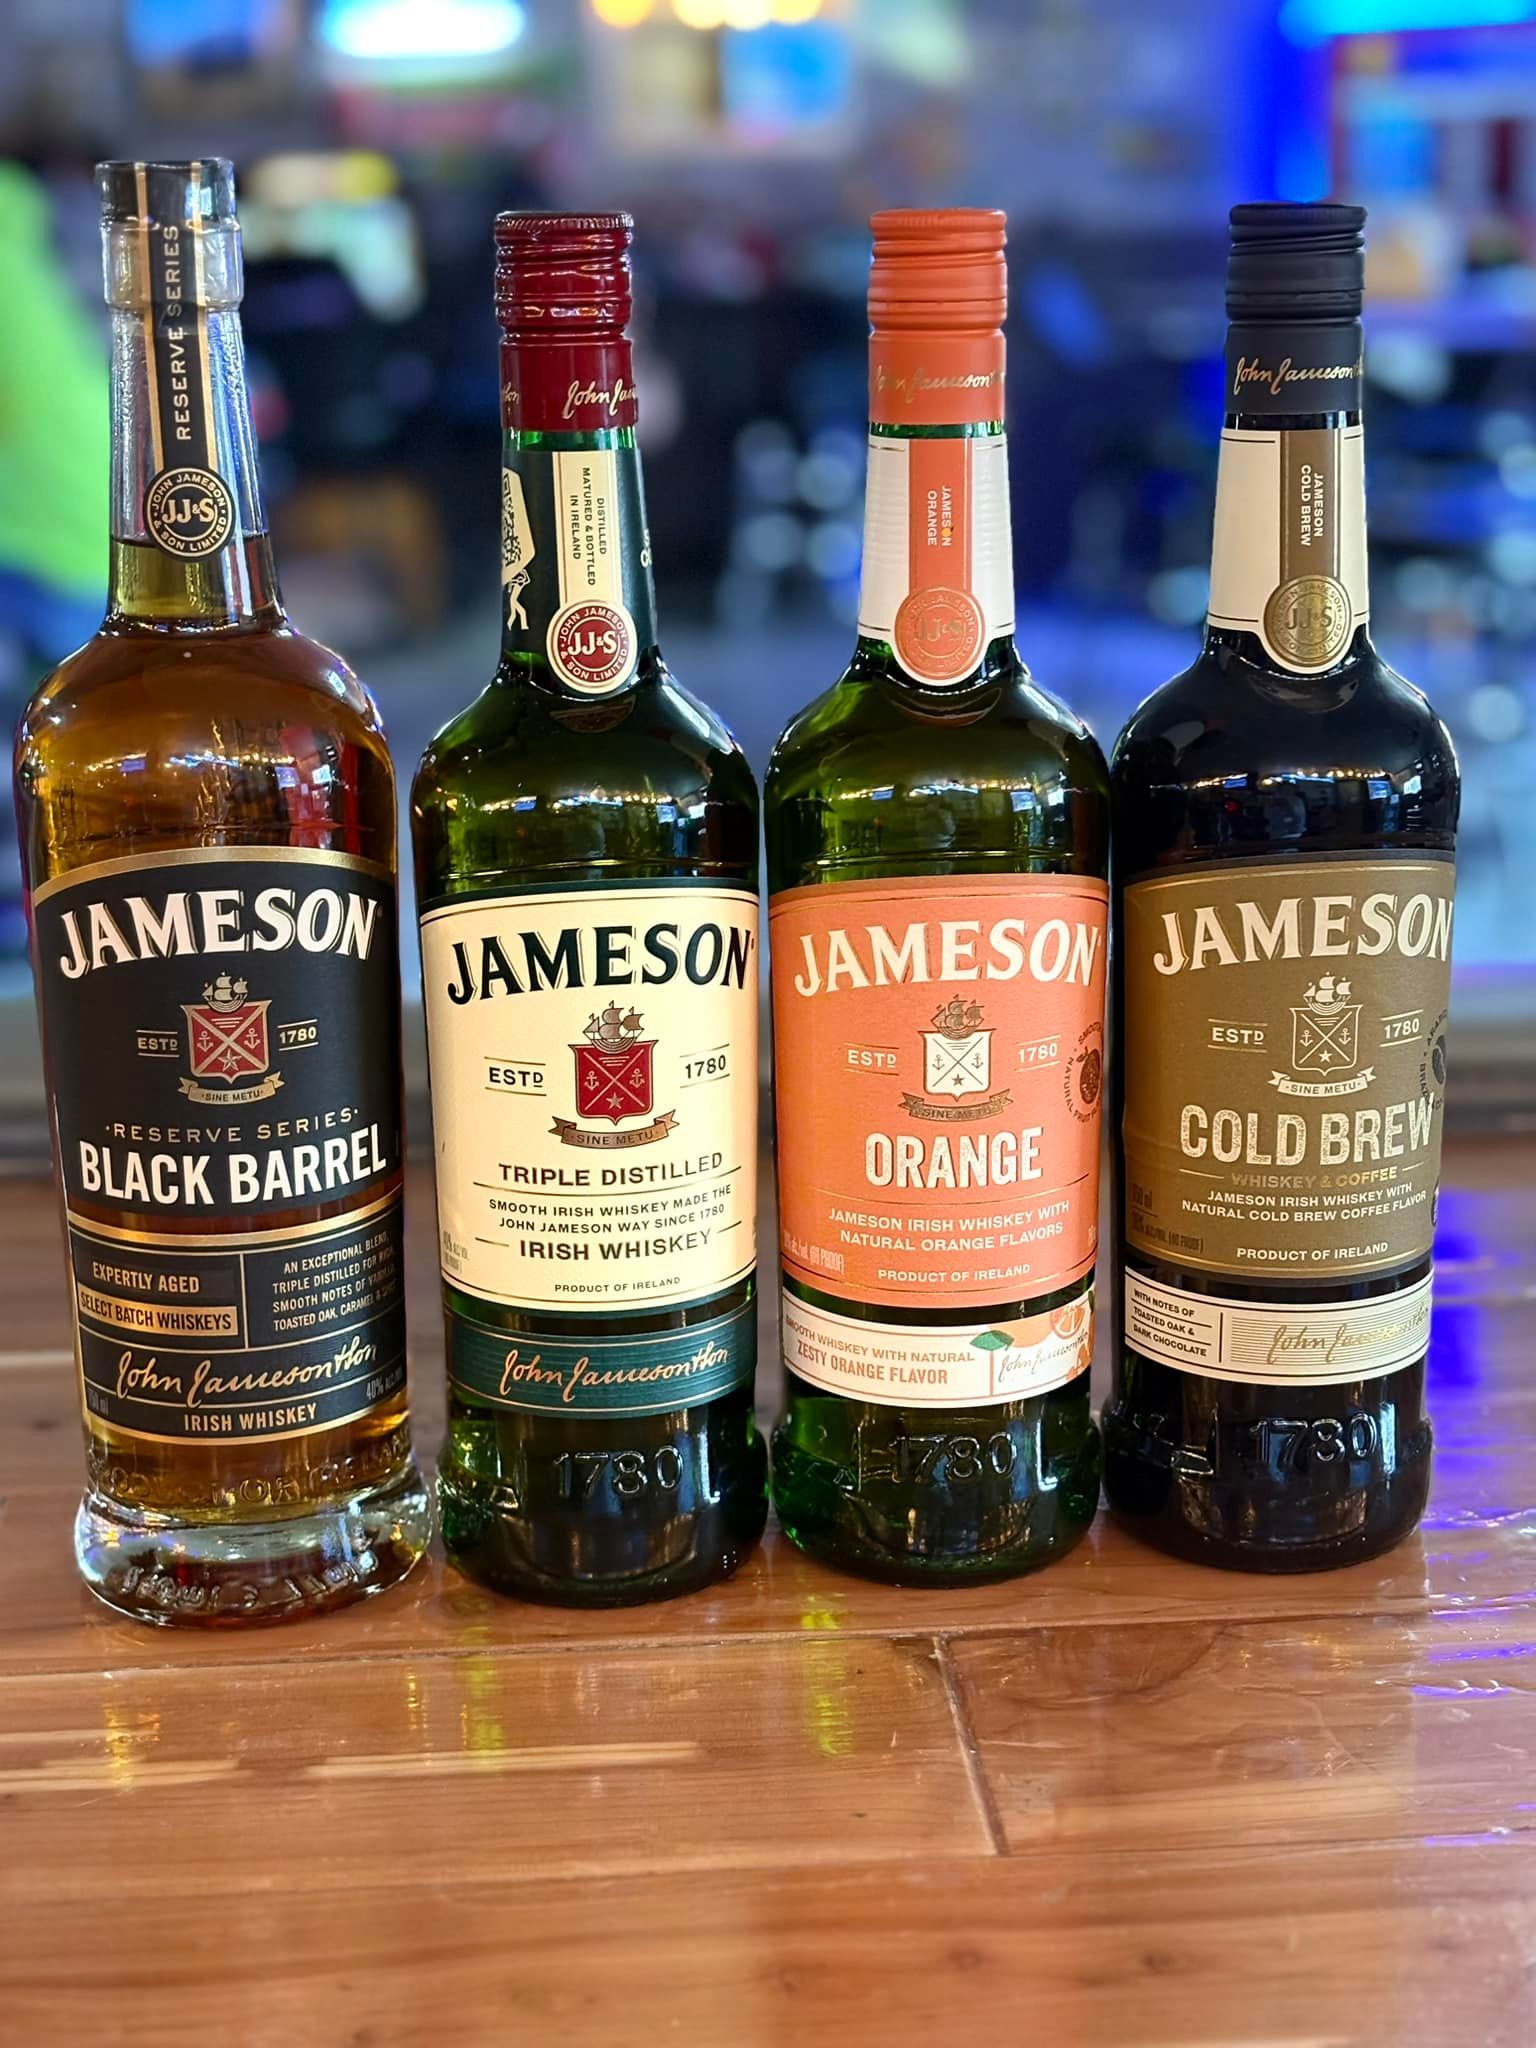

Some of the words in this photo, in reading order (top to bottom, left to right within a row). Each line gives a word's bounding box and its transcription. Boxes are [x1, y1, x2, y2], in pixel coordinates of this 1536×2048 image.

[165, 224, 184, 317] SERIES
[172, 327, 193, 441] RESERVE
[1233, 357, 1272, 395] John
[1270, 358, 1352, 395] Jameson
[562, 381, 610, 419] John
[152, 479, 173, 510] JOHN
[177, 473, 226, 507] JAMESON
[570, 495, 578, 504] IN
[583, 467, 593, 523] MATURED
[1301, 464, 1311, 501] COLD
[162, 498, 214, 523] JJ&S
[927, 490, 938, 546] ORANGE
[1314, 472, 1324, 537] JAMESON
[160, 531, 185, 550] SON
[190, 517, 227, 551] LIMITED
[571, 504, 581, 560] IRELAND
[597, 498, 607, 555] DISTILLED
[1301, 506, 1311, 546] BREW
[586, 534, 596, 586] BOTTLED
[560, 613, 580, 642] JOHN
[584, 607, 627, 638] JAMESON
[567, 630, 617, 655] JJ&S
[567, 661, 589, 680] SON
[593, 649, 627, 680] LIMITED
[60, 888, 378, 979] JAMESON
[1153, 894, 1454, 977] JAMESON
[447, 923, 751, 1005] JAMESON
[794, 919, 1099, 997] JAMESON
[279, 1026, 317, 1044] 1780
[1383, 1018, 1420, 1040] 1780
[684, 1055, 727, 1079] 1780
[1018, 1043, 1057, 1064] 1780
[205, 1092, 229, 1102] SINE
[232, 1089, 262, 1101] METU
[1290, 1083, 1319, 1095] SINE
[1324, 1080, 1356, 1095] METU
[114, 1122, 242, 1143] RESERVE
[257, 1108, 352, 1139] SERIES
[577, 1134, 609, 1145] SINE
[616, 1130, 654, 1144] METU
[1179, 1104, 1308, 1167] COLD
[1319, 1092, 1434, 1167] BREW
[79, 1140, 214, 1205] BLACK
[229, 1123, 387, 1204] BARREL
[498, 1163, 590, 1187] TRIPLE
[602, 1152, 723, 1186] DISTILLED
[864, 1126, 1044, 1190] ORANGE
[1208, 1191, 1275, 1206] JAMESON
[1281, 1196, 1318, 1207] IRISH
[1323, 1190, 1384, 1206] WHISKEY
[1387, 1182, 1412, 1198] WITH
[1232, 1172, 1317, 1189] WHISKEY
[1335, 1166, 1398, 1187] COFFEE
[489, 1199, 547, 1216] SMOOTH
[553, 1205, 594, 1217] IRISH
[600, 1201, 669, 1217] WHISKEY
[673, 1193, 708, 1211] MADE
[712, 1184, 732, 1199] THE
[499, 1217, 536, 1231] JOHN
[540, 1220, 612, 1233] JAMESON
[618, 1220, 650, 1233] WAY
[654, 1211, 696, 1229] SINCE
[699, 1203, 725, 1219] 1780
[828, 1207, 902, 1231] JAMESON
[908, 1219, 953, 1232] IRISH
[959, 1211, 1034, 1231] WHISKEY
[1037, 1200, 1070, 1220] WITH
[1182, 1200, 1245, 1219] NATURAL
[1249, 1210, 1290, 1222] COLD
[1294, 1210, 1337, 1222] BREW
[1341, 1203, 1390, 1220] COFFEE
[1392, 1190, 1426, 1211] FLAVOR
[520, 1239, 590, 1261] IRISH
[601, 1228, 711, 1260] WHISKEY
[840, 1230, 915, 1251] NATURAL
[921, 1233, 996, 1252] ORANGE
[1000, 1221, 1063, 1247] FLAVORS
[1237, 1247, 1307, 1261] PRODUCT
[1311, 1249, 1330, 1261] OF
[1334, 1242, 1388, 1259] IRELAND
[272, 1277, 310, 1294] TRIPLE
[314, 1263, 360, 1287] DISTILLED
[363, 1254, 377, 1270] FOR
[284, 1261, 298, 1274] AN
[302, 1243, 363, 1271] EXCEPTIONAL
[877, 1269, 946, 1283] PRODUCT
[951, 1269, 969, 1283] OF
[974, 1263, 1031, 1281] IRELAND
[92, 1261, 152, 1290] EXPERTLY
[158, 1275, 200, 1293] AGED
[555, 1284, 610, 1293] PRODUCT
[614, 1283, 629, 1292] OF
[632, 1276, 681, 1291] IRELAND
[80, 1292, 113, 1318] SELECT
[115, 1305, 153, 1327] BATCH
[157, 1311, 231, 1330] WHISKEYS
[273, 1294, 318, 1313] SMOOTH
[322, 1284, 353, 1303] NOTES
[355, 1278, 366, 1291] OF
[274, 1313, 316, 1331] TOASTED
[340, 1294, 374, 1315] CARAMEL
[1134, 1288, 1151, 1304] WITH
[1152, 1298, 1180, 1313] NOTES
[1182, 1307, 1195, 1317] OF
[1133, 1306, 1165, 1326] TOASTED
[1167, 1321, 1186, 1334] OAK
[1188, 1327, 1195, 1335] &
[818, 1333, 869, 1356] WHISKEY
[872, 1347, 906, 1361] WITH
[911, 1351, 975, 1363] NATURAL
[1133, 1323, 1152, 1339] DARK
[1153, 1334, 1207, 1356] CHOCOLATE
[1267, 1325, 1325, 1364] John
[117, 1351, 181, 1398] John
[187, 1358, 332, 1408] Jameson
[499, 1349, 563, 1395] John
[562, 1356, 690, 1402] Jameson
[797, 1340, 828, 1366] ZESTY
[831, 1355, 885, 1381] ORANGE
[889, 1367, 948, 1384] FLAVOR
[184, 1413, 232, 1431] IRISH
[239, 1402, 317, 1430] WHISKEY
[553, 1445, 685, 1497] 1780
